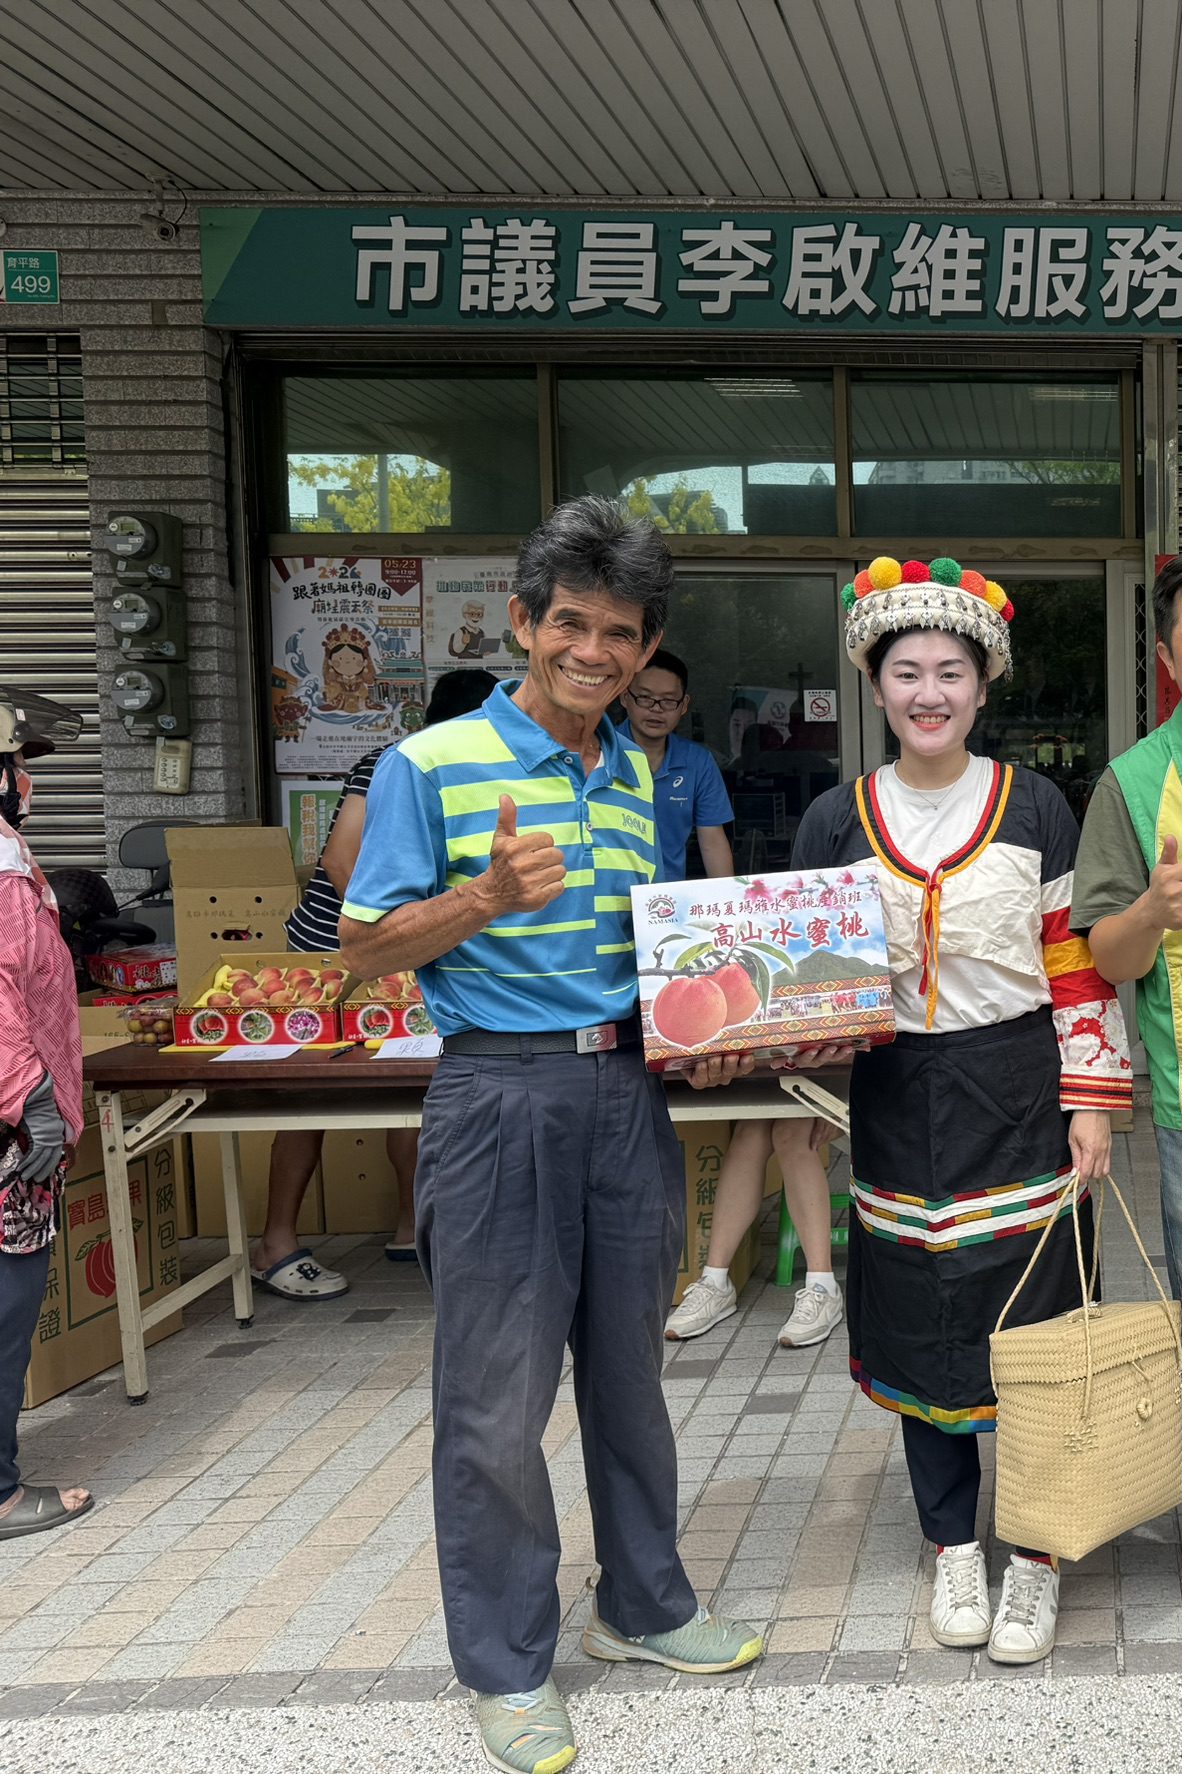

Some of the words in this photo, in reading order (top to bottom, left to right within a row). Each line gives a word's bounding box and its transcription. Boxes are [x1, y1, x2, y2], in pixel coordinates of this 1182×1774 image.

[7, 257, 40, 269] 育平路
[11, 275, 51, 293] 499
[711, 911, 869, 948] 高山水蜜桃
[101, 1109, 114, 1133] 4
[67, 1179, 142, 1231] 寶島果
[153, 1148, 178, 1287] 分級包裝
